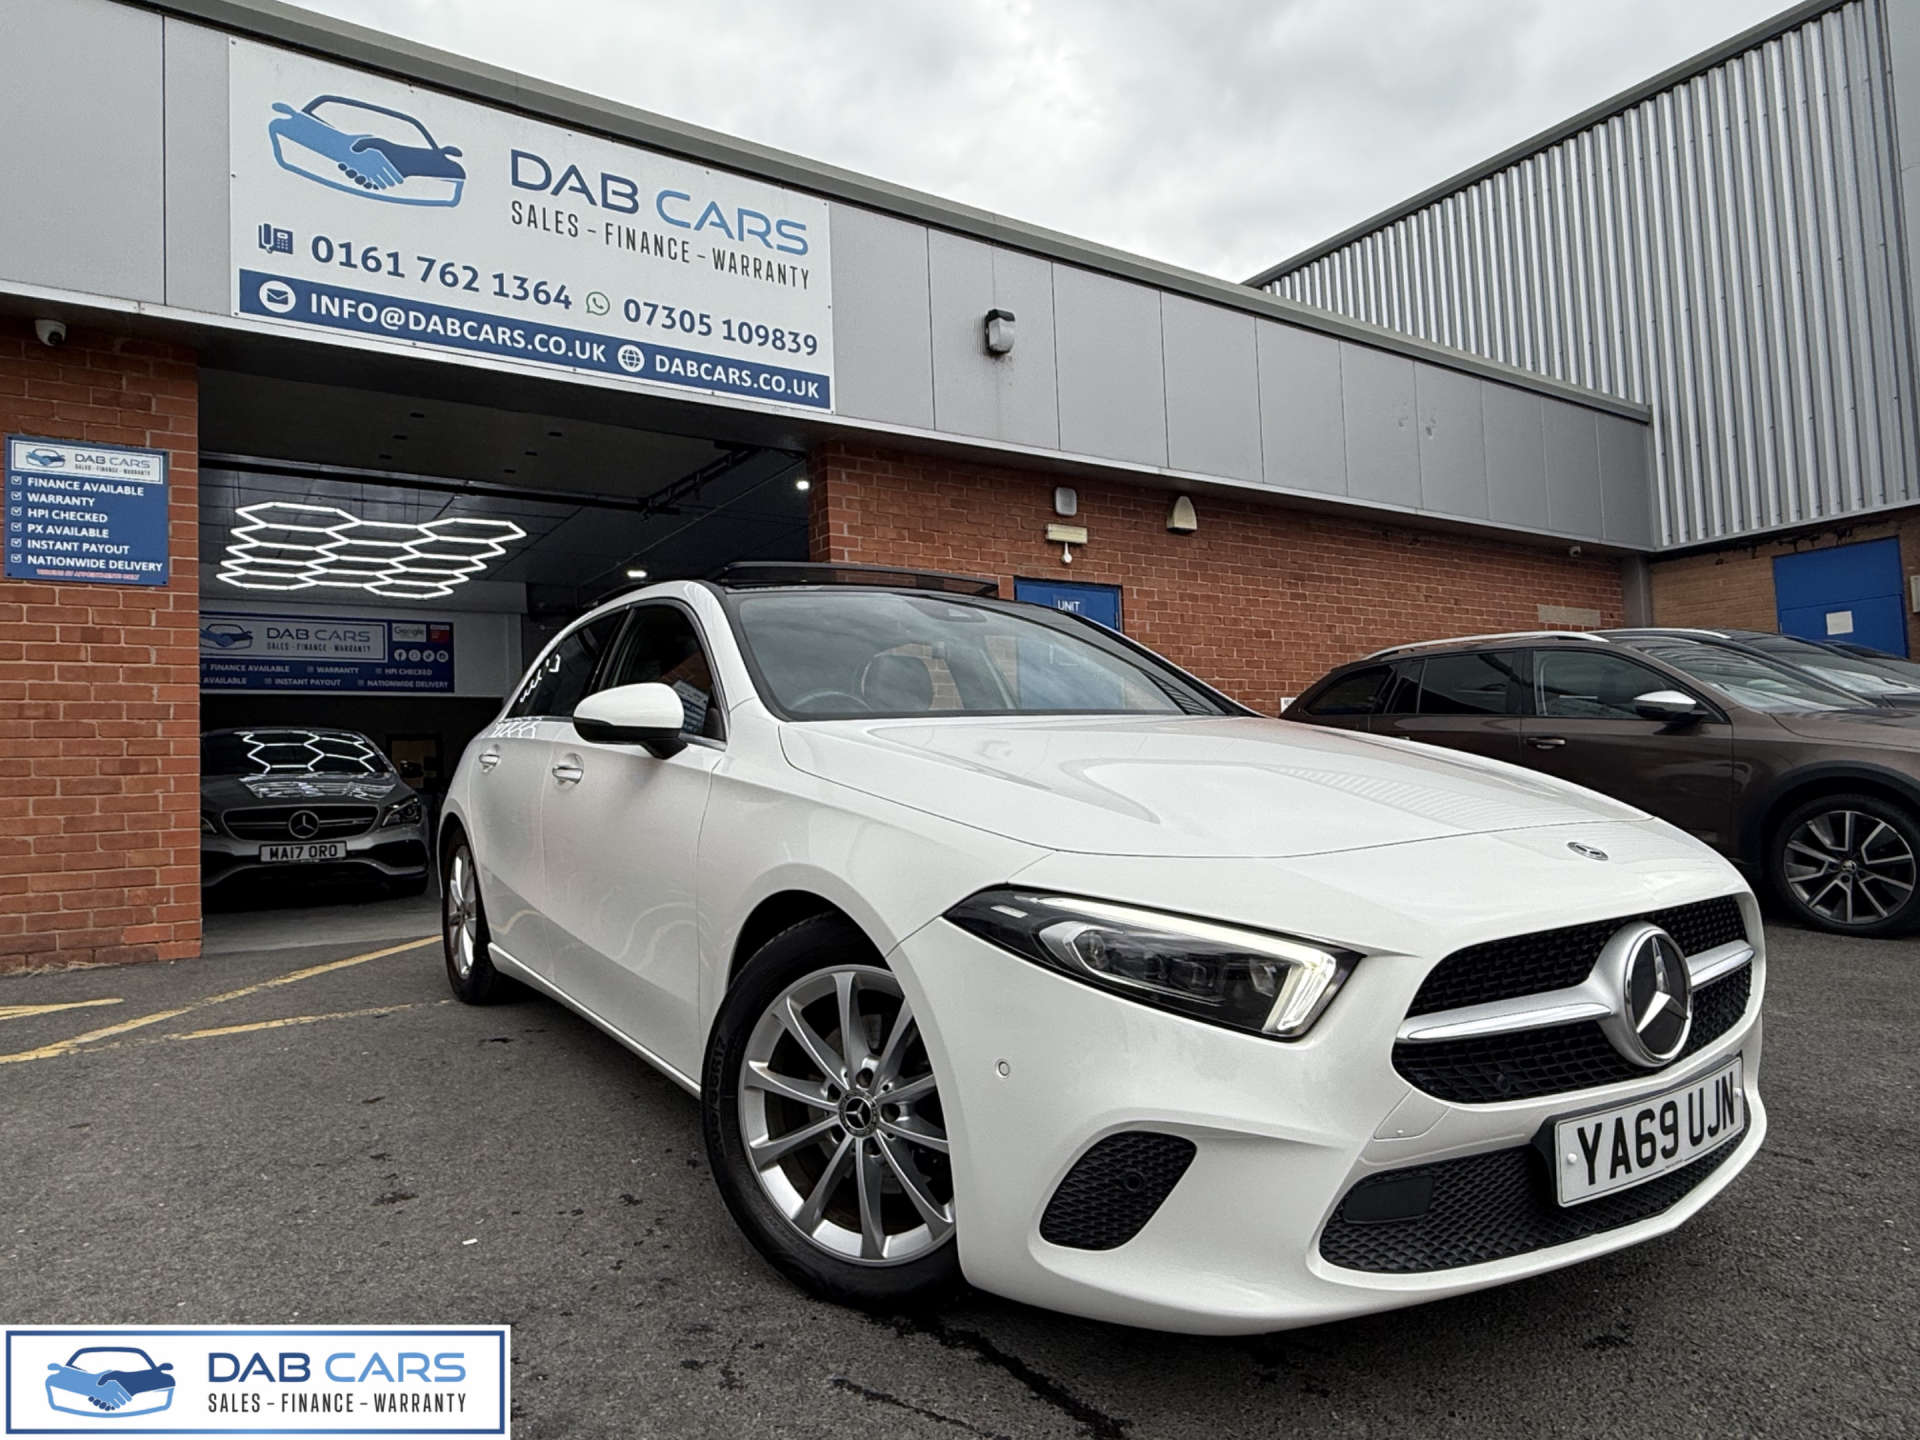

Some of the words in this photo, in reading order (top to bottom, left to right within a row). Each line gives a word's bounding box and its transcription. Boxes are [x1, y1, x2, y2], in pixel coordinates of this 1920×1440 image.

[510, 149, 639, 214] DAB
[656, 190, 808, 256] CARS
[511, 200, 579, 238] SALES
[605, 225, 690, 264] FINANCE
[712, 249, 810, 290] WARRANTY
[311, 235, 405, 279] 0161
[416, 256, 480, 292] 762
[493, 273, 572, 310] 1364
[310, 293, 607, 364] INFO@DABCARS.CO.UK
[623, 298, 712, 335] 07305
[722, 321, 818, 357] 109839
[655, 353, 819, 400] DABCARS.CO.UK
[74, 453, 106, 465] DAB
[109, 455, 151, 469] CARS
[27, 477, 80, 491] FINANCE
[83, 483, 144, 497] AVAILABLE
[27, 493, 95, 507] WARRANTY
[27, 508, 49, 519] HPI
[51, 510, 108, 523] CHECKED
[27, 524, 43, 534] PX
[46, 525, 109, 538] AVAILABLE
[27, 540, 79, 552] INSTANT
[82, 544, 130, 555] PAYOUT
[27, 555, 106, 569] NATIONWIDE
[109, 559, 163, 572] DELIVERY
[1057, 600, 1080, 612] UNIT
[266, 628, 310, 640] DAB
[314, 629, 371, 642] CARS
[210, 664, 245, 672] FINANCE
[247, 665, 291, 673] AVAILABLE
[316, 666, 360, 674] WARRANTY
[203, 677, 247, 685] AVAILABLE
[275, 678, 308, 686] INSTANT
[367, 680, 414, 688] NATIONWIDE
[416, 681, 449, 689] DELIVERY
[1577, 1100, 1680, 1186] YA69
[1688, 1071, 1736, 1147] UJN
